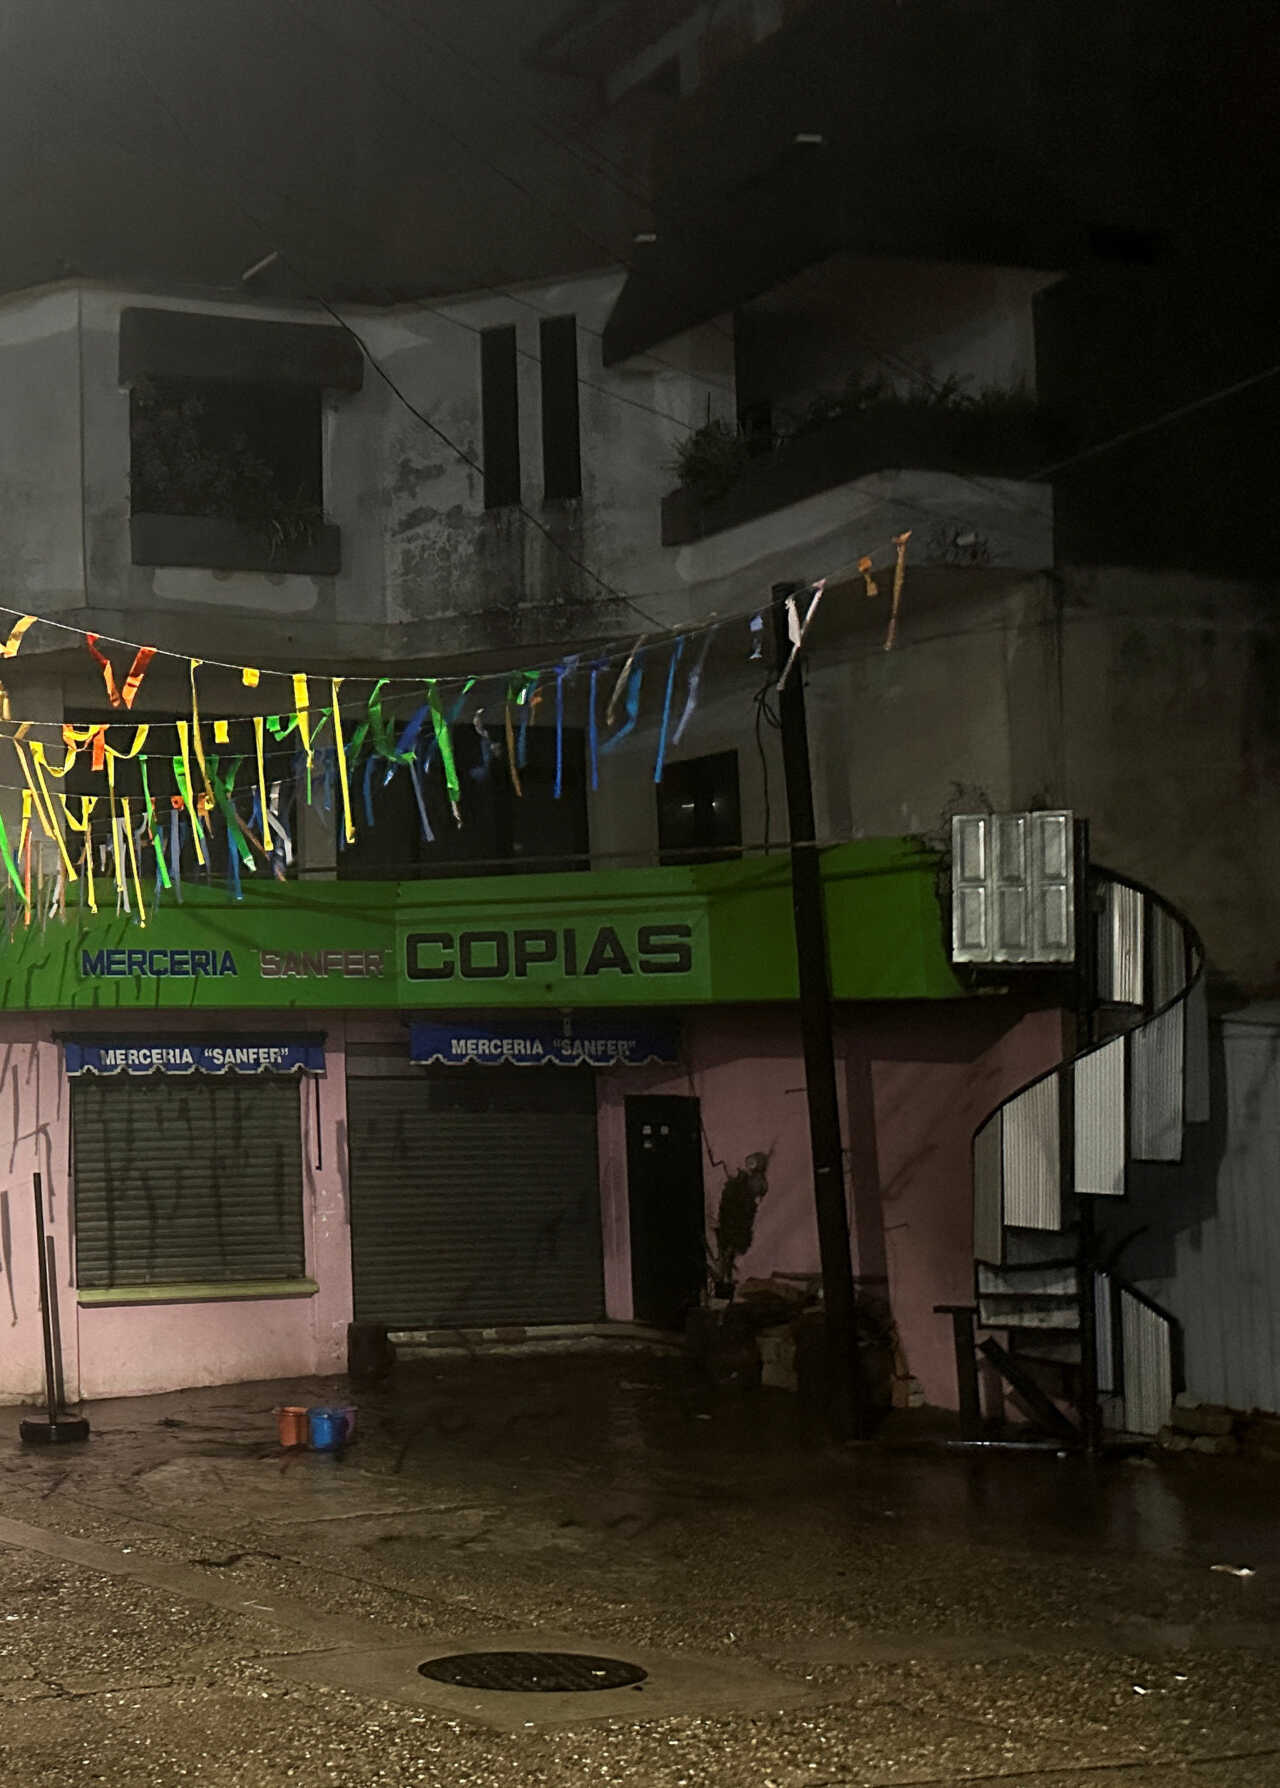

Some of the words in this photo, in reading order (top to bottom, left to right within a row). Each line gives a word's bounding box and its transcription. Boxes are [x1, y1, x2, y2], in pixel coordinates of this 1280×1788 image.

[81, 949, 239, 978] MERCERIA
[406, 925, 692, 980] COPIAS
[100, 1048, 194, 1065] MERCERIA
[204, 1048, 289, 1065] "SANFER"
[448, 1039, 544, 1055] MERCERIA
